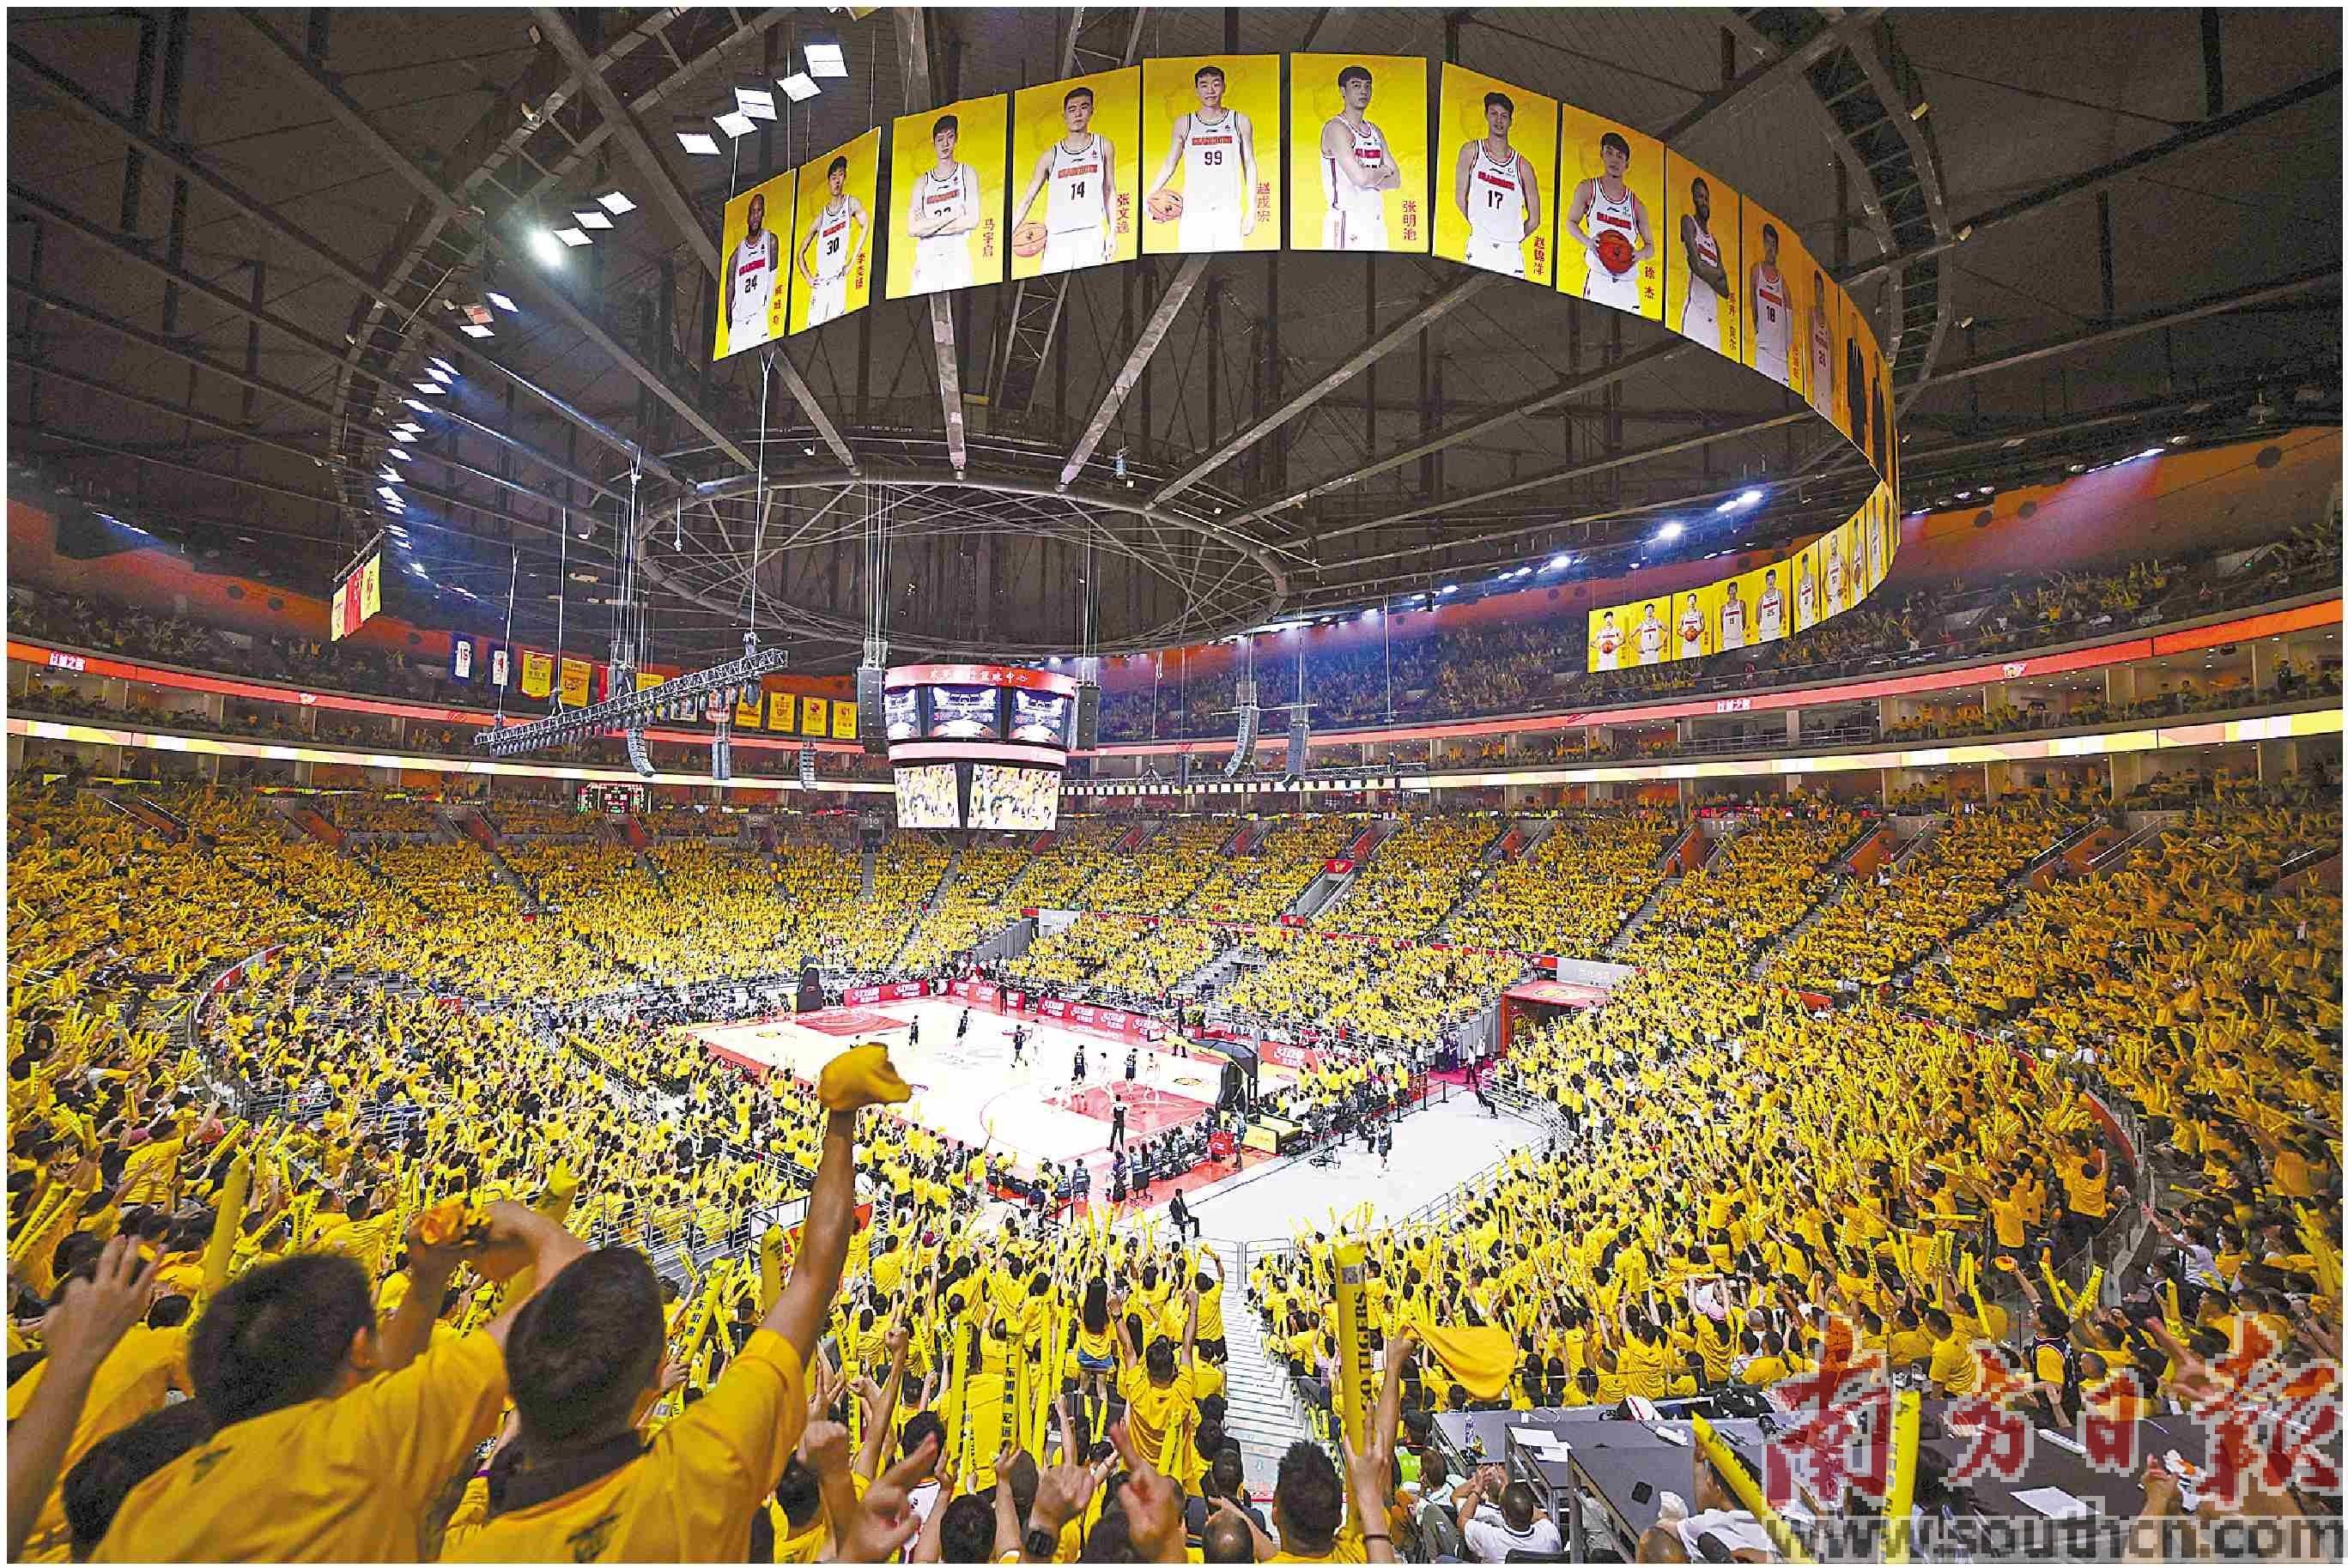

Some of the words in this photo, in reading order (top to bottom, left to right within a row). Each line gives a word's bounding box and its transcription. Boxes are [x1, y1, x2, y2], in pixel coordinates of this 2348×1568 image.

[1204, 150, 1223, 166] 99
[1070, 181, 1085, 201] 14
[1487, 190, 1504, 210] 17
[1401, 199, 1417, 240] 张明池
[826, 237, 840, 256] 30
[743, 275, 758, 294] 24
[1355, 1291, 1371, 1373] TIGERS
